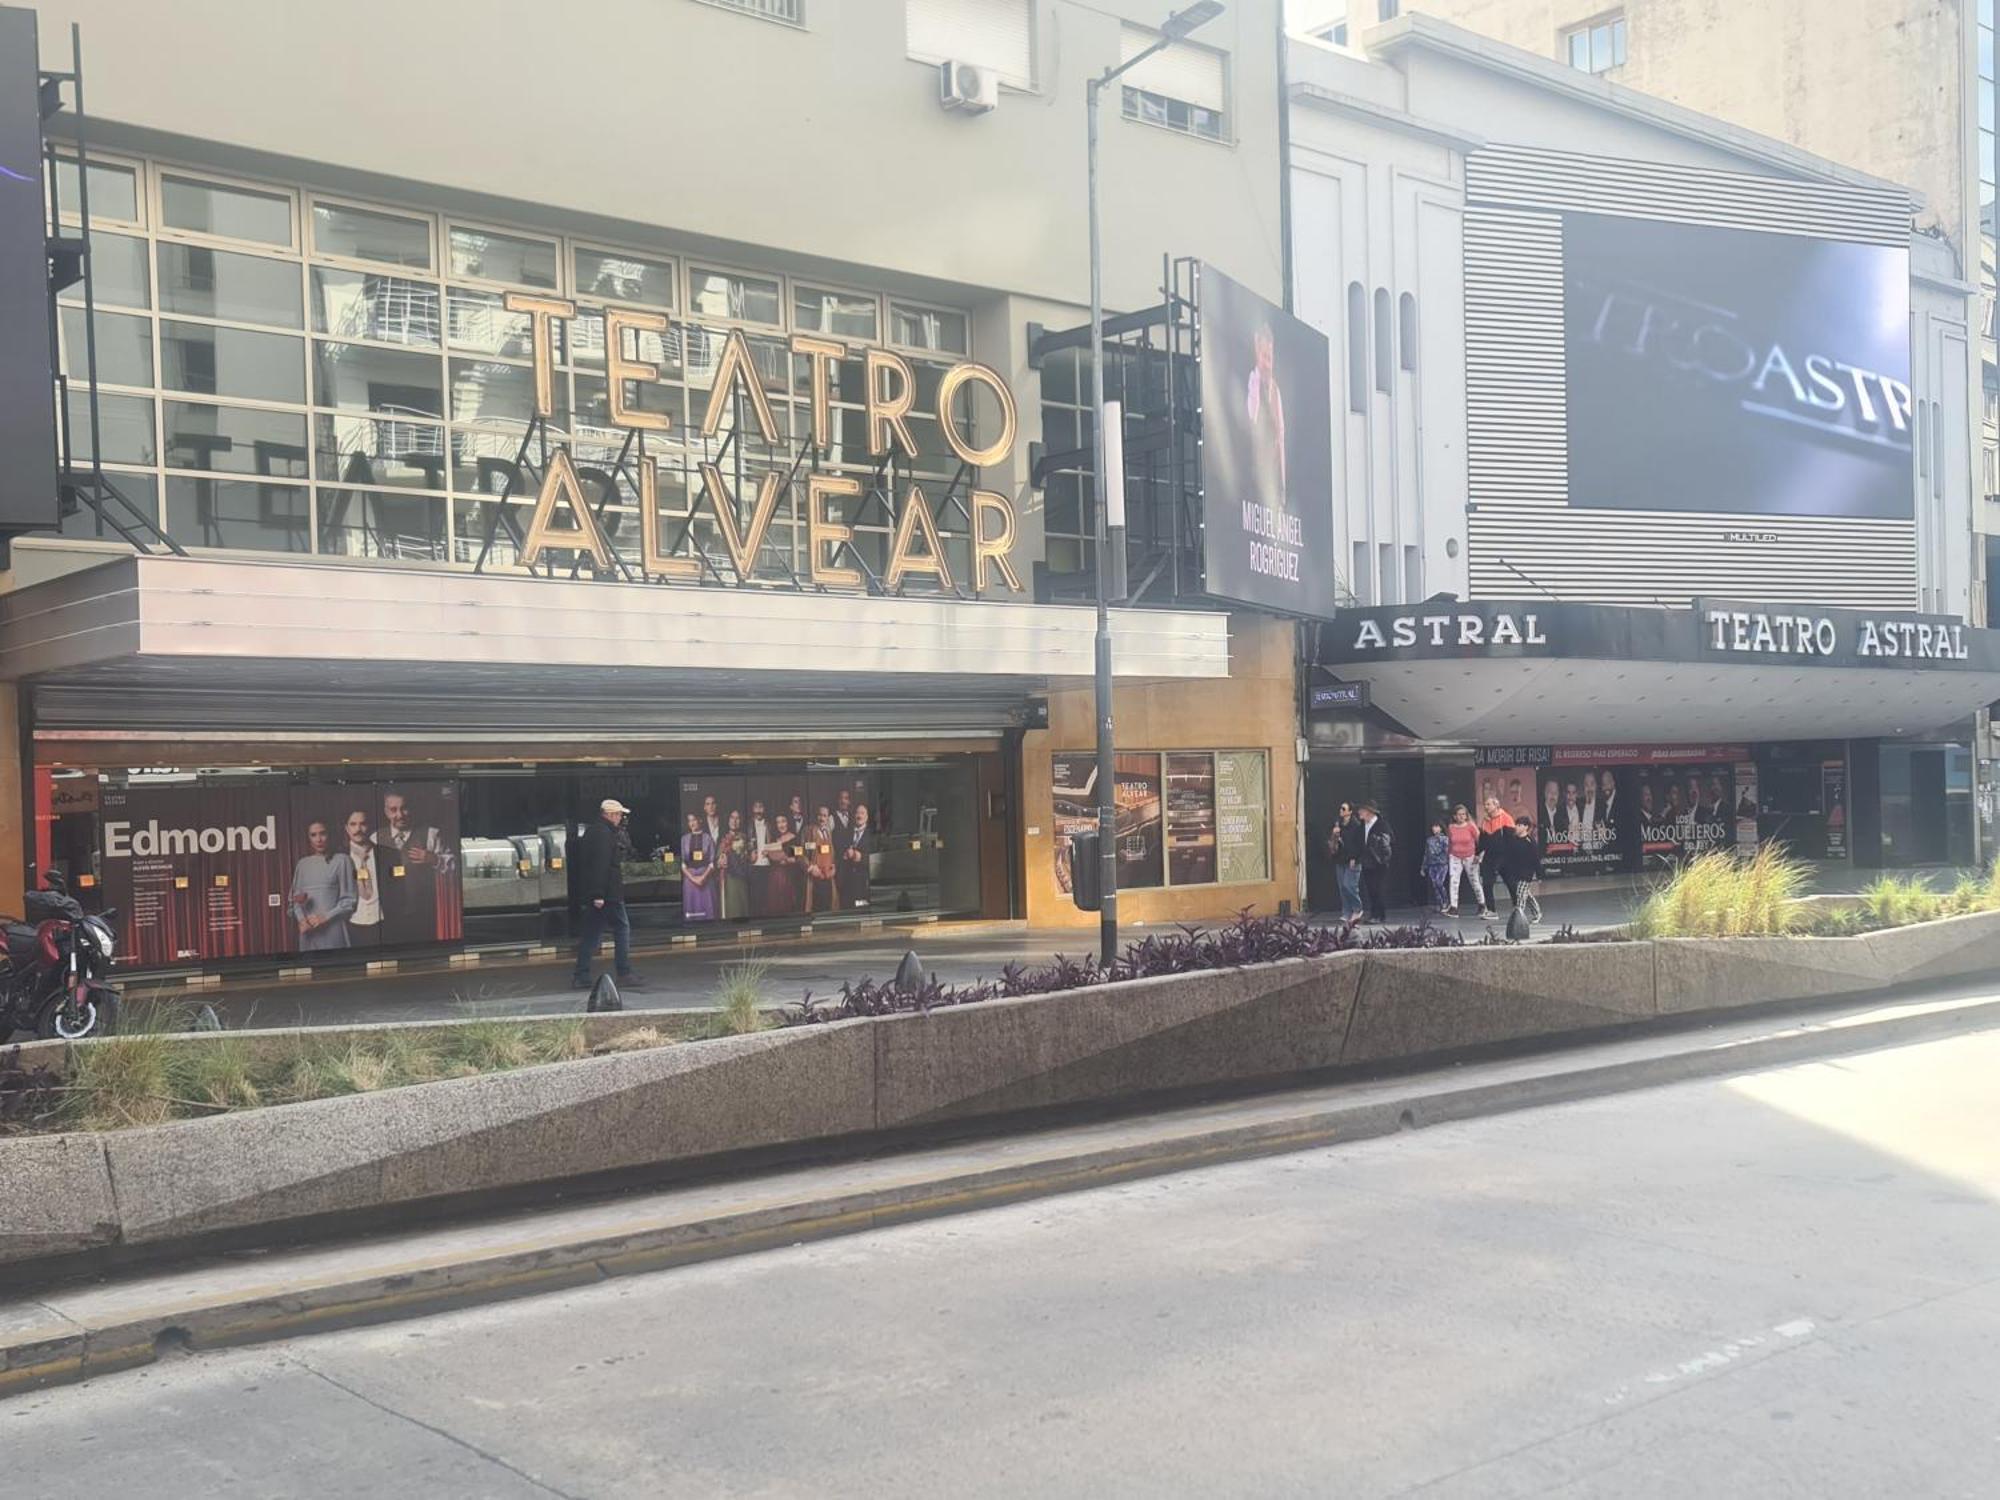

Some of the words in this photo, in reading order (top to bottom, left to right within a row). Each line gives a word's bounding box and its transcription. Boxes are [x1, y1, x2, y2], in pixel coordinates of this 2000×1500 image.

[504, 291, 1017, 467] TEATRO
[516, 447, 1024, 594] ALVEAR
[1242, 500, 1276, 540] MIGUEL
[1354, 614, 1546, 649] ASTRAL
[1709, 610, 1836, 656] TEATRO
[1861, 620, 1968, 660] ASTRAL
[104, 815, 276, 857] Edmond
